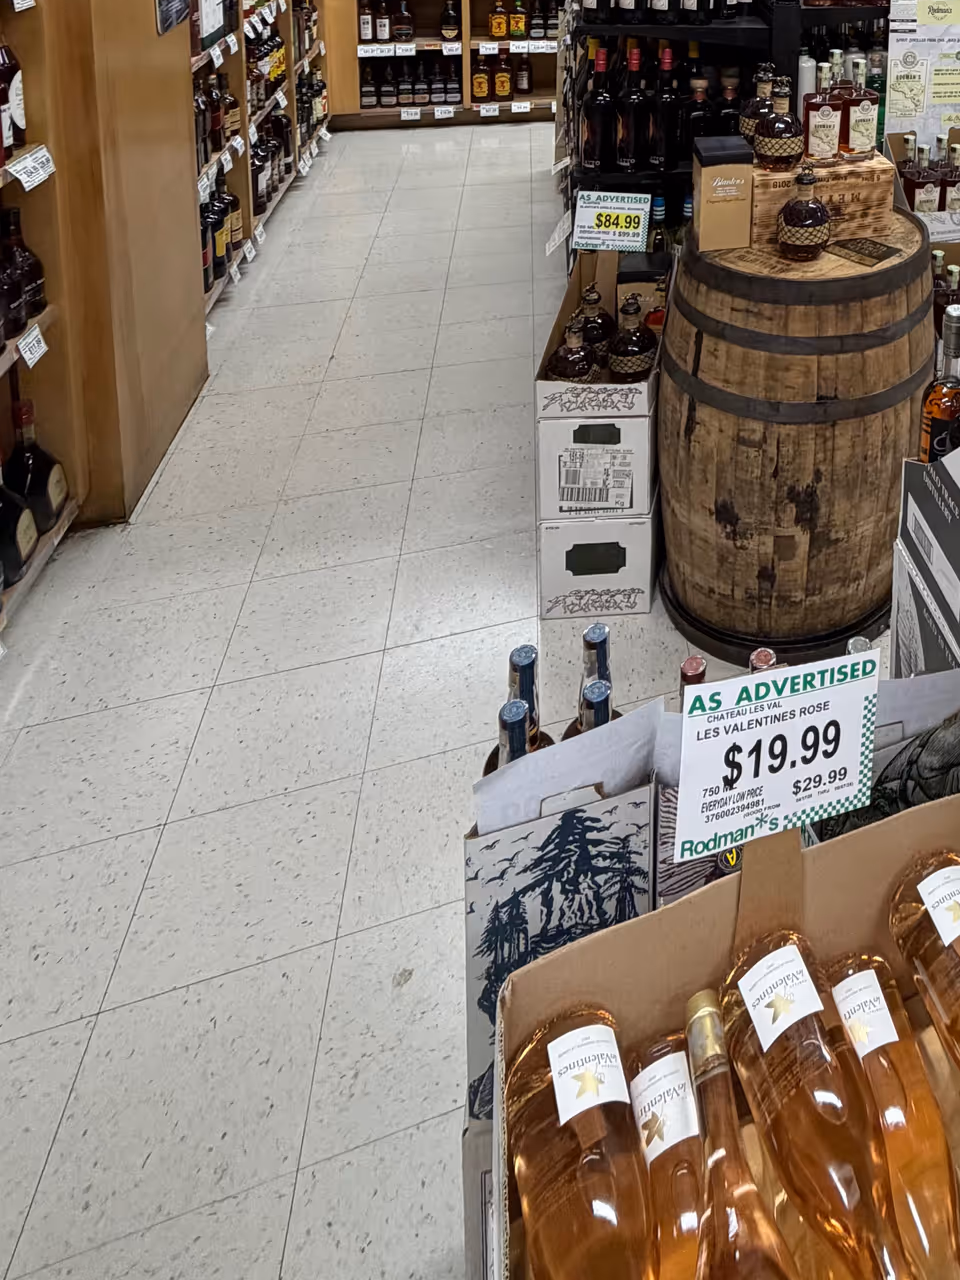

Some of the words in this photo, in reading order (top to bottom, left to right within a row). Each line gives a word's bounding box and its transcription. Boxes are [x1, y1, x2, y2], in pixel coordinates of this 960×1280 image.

[712, 176, 744, 187] Blanton's
[772, 180, 791, 188] 2018
[596, 195, 649, 203] ADVERTISED
[595, 213, 640, 229] $84.99
[941, 486, 960, 520] TRACE
[688, 692, 722, 716] AS
[735, 659, 877, 707] ADVERTISED
[696, 725, 720, 742] LES
[724, 709, 796, 736] VALENTINES
[799, 701, 830, 717] ROSE
[707, 708, 747, 723] CHATEAU
[749, 704, 765, 715] LES
[767, 701, 782, 712] VAL
[722, 719, 841, 792] $19.99
[702, 785, 719, 799] 750
[792, 767, 848, 797] $29.99
[701, 793, 733, 814] EVERYDAY
[733, 790, 748, 806] LOW
[749, 786, 764, 800] PRICE
[762, 803, 781, 814] FROM
[680, 814, 779, 859] Rodman's
[751, 970, 799, 1011] Valentines
[557, 1053, 612, 1078] Valentines
